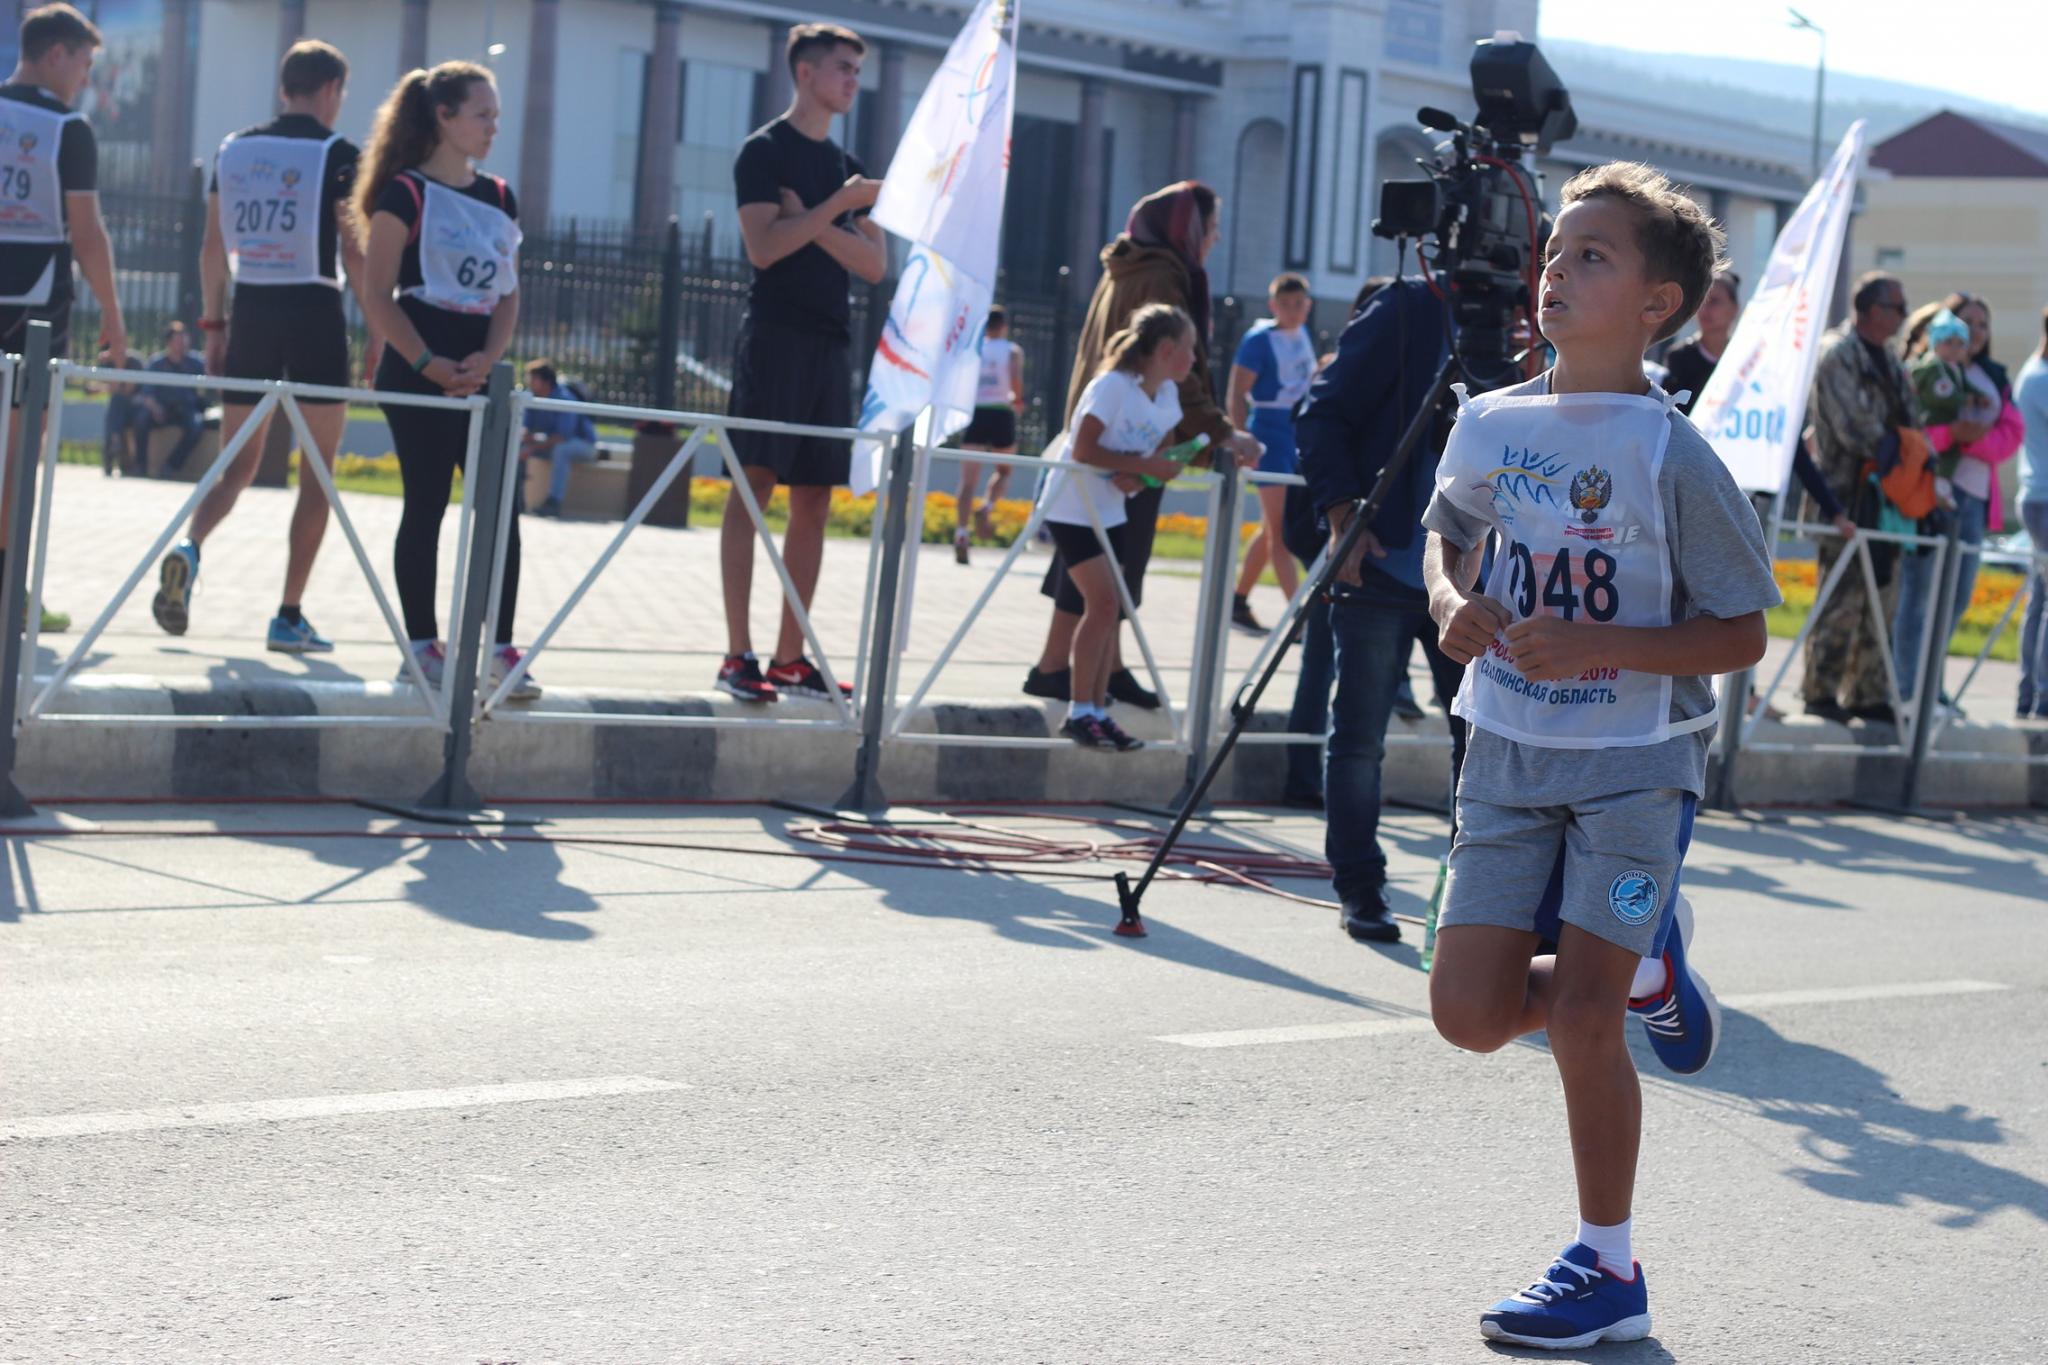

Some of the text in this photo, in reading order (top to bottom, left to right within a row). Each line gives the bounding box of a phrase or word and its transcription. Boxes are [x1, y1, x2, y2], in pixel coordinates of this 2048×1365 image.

[235, 199, 297, 233] 2075
[457, 255, 497, 290] 62
[1549, 687, 1617, 705] ОБЛАСТЬ
